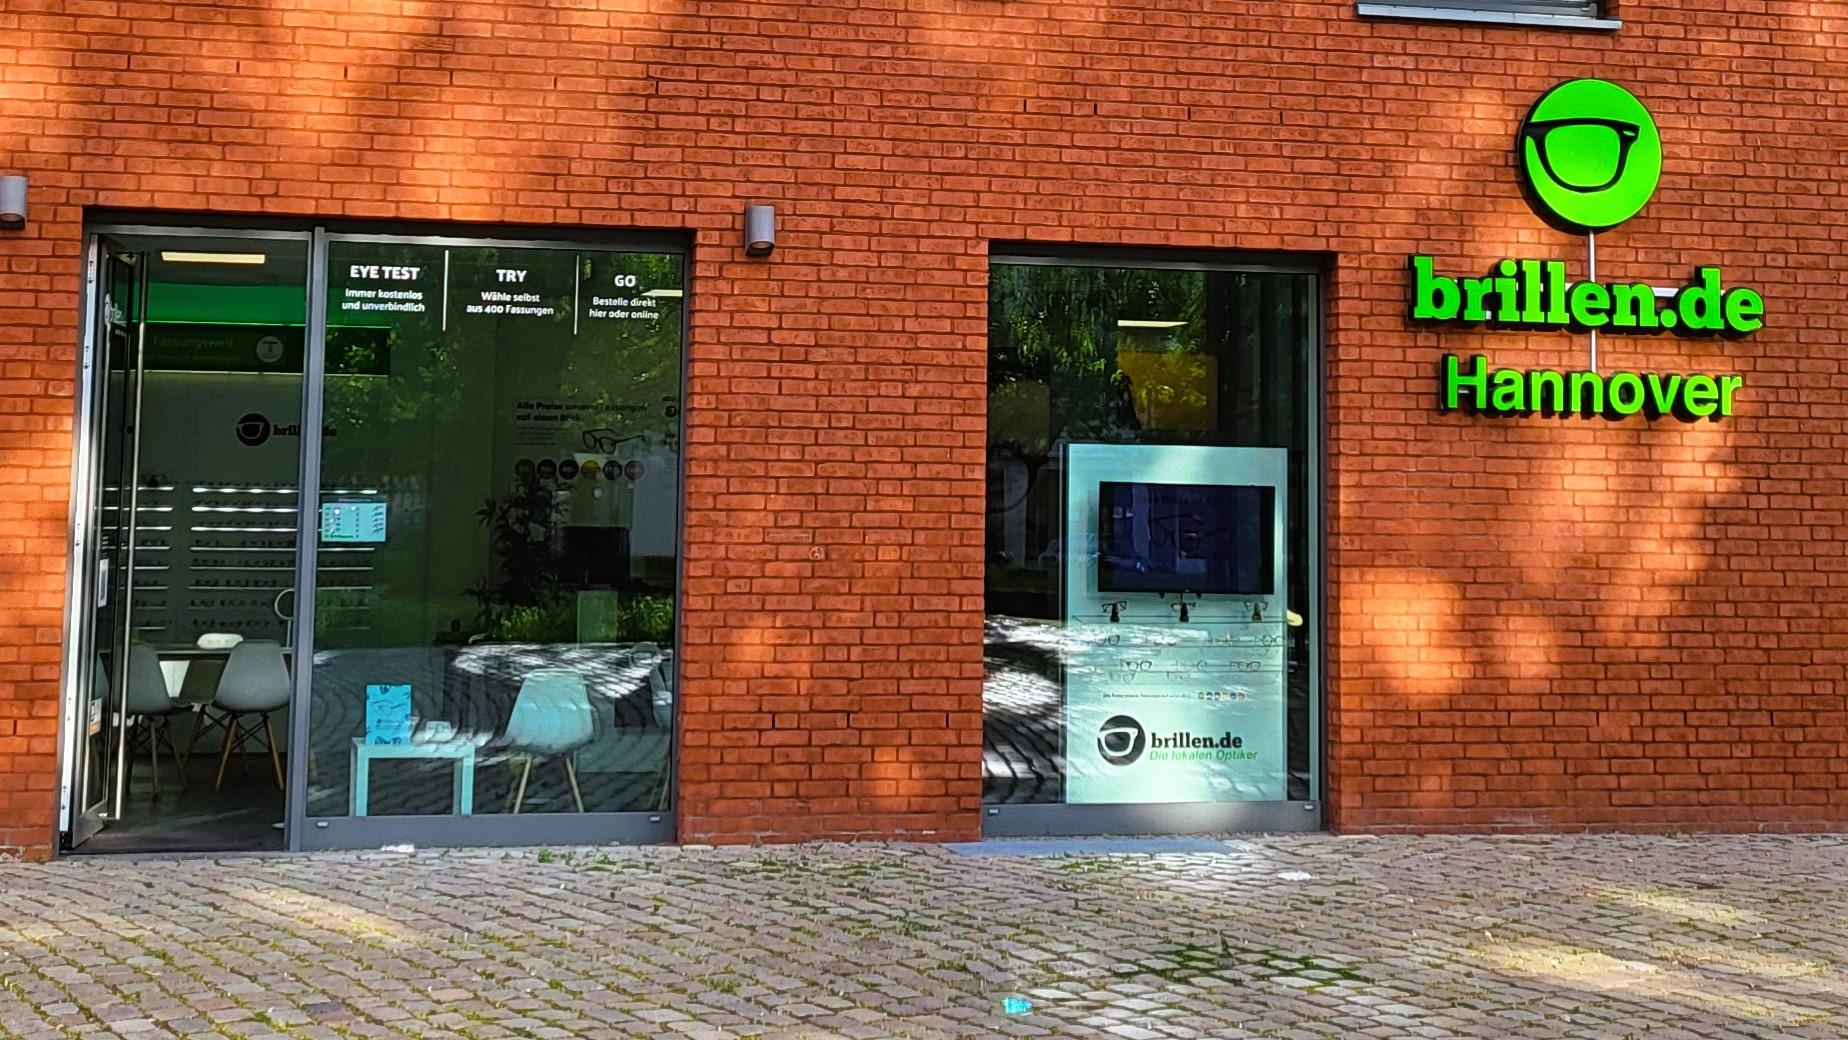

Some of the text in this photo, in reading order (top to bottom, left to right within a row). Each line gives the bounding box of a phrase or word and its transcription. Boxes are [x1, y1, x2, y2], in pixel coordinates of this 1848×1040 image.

[350, 265, 420, 280] EYE TEST
[496, 269, 527, 282] TRY
[614, 275, 636, 288] GO
[345, 288, 423, 300] Immer kostenlos
[481, 291, 540, 303] Wähle selbst
[1413, 255, 1765, 332] brillen.de
[342, 301, 425, 312] und unverbindlich
[593, 296, 656, 308] Bestelle direkt
[466, 304, 554, 316] aus 400 Fassungen
[589, 308, 659, 320] hier oder online
[1446, 354, 1743, 417] Hannover
[273, 424, 337, 436] brillde
[1151, 732, 1243, 749] brillen.de
[1150, 750, 1259, 762] Die lokalen Optiker
